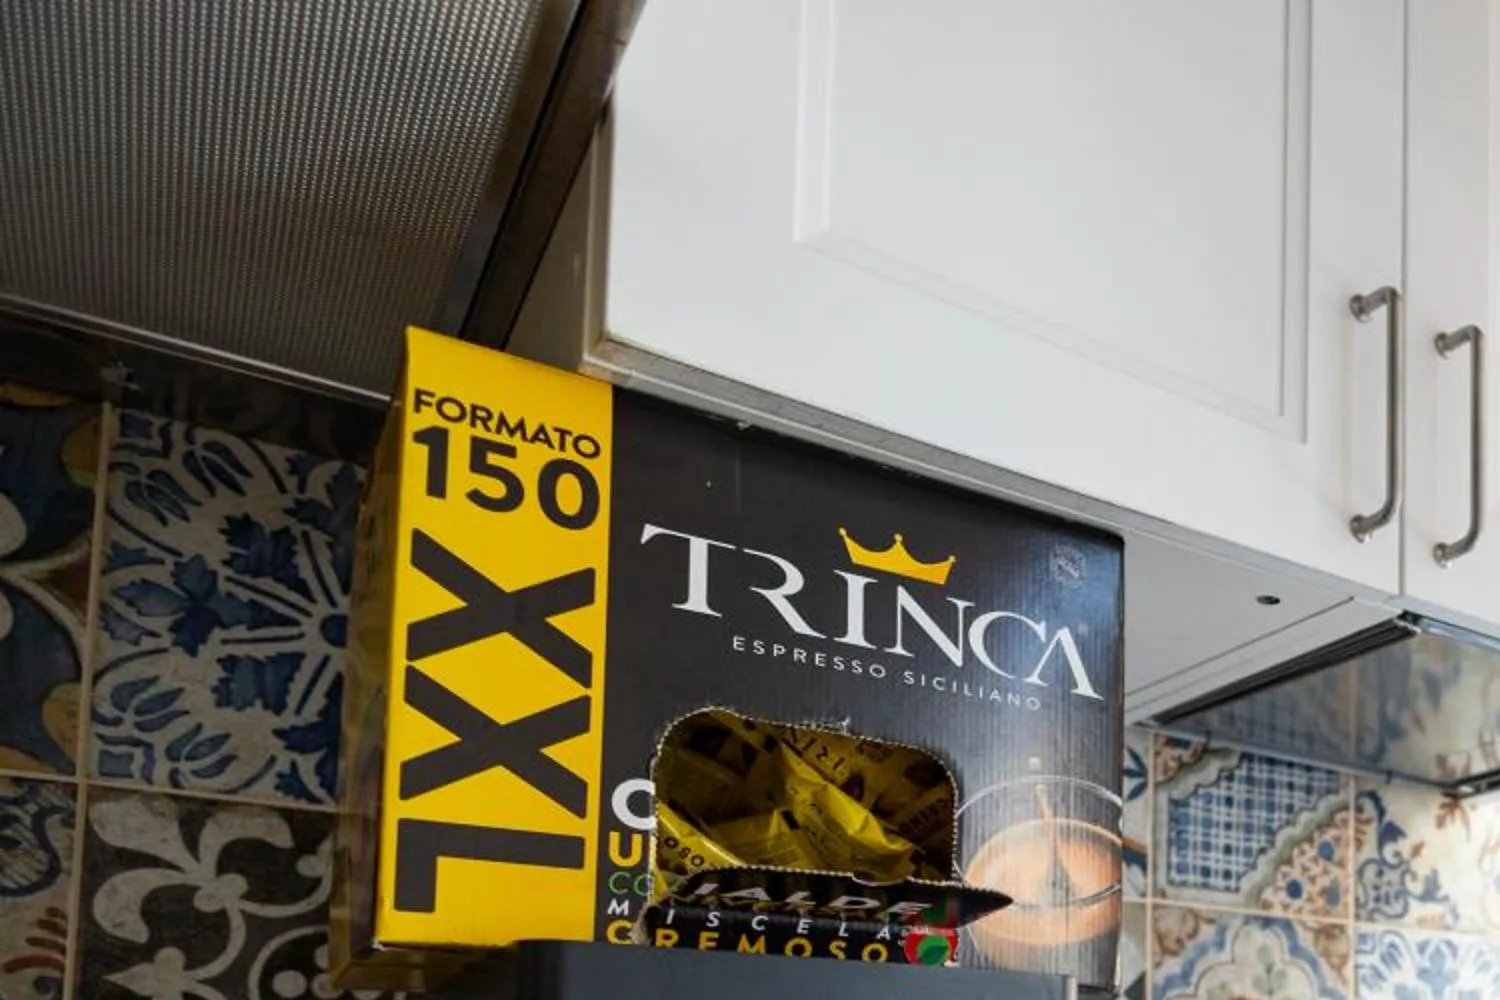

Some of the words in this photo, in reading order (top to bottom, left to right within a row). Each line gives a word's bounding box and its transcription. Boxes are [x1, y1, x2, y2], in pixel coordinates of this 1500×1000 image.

[412, 388, 602, 461] FORMATO
[411, 426, 601, 531] 150
[640, 523, 1104, 701] TRINCA
[393, 527, 597, 914] XXL
[732, 635, 887, 679] ESPRESSO
[903, 671, 1042, 711] SICILIANO
